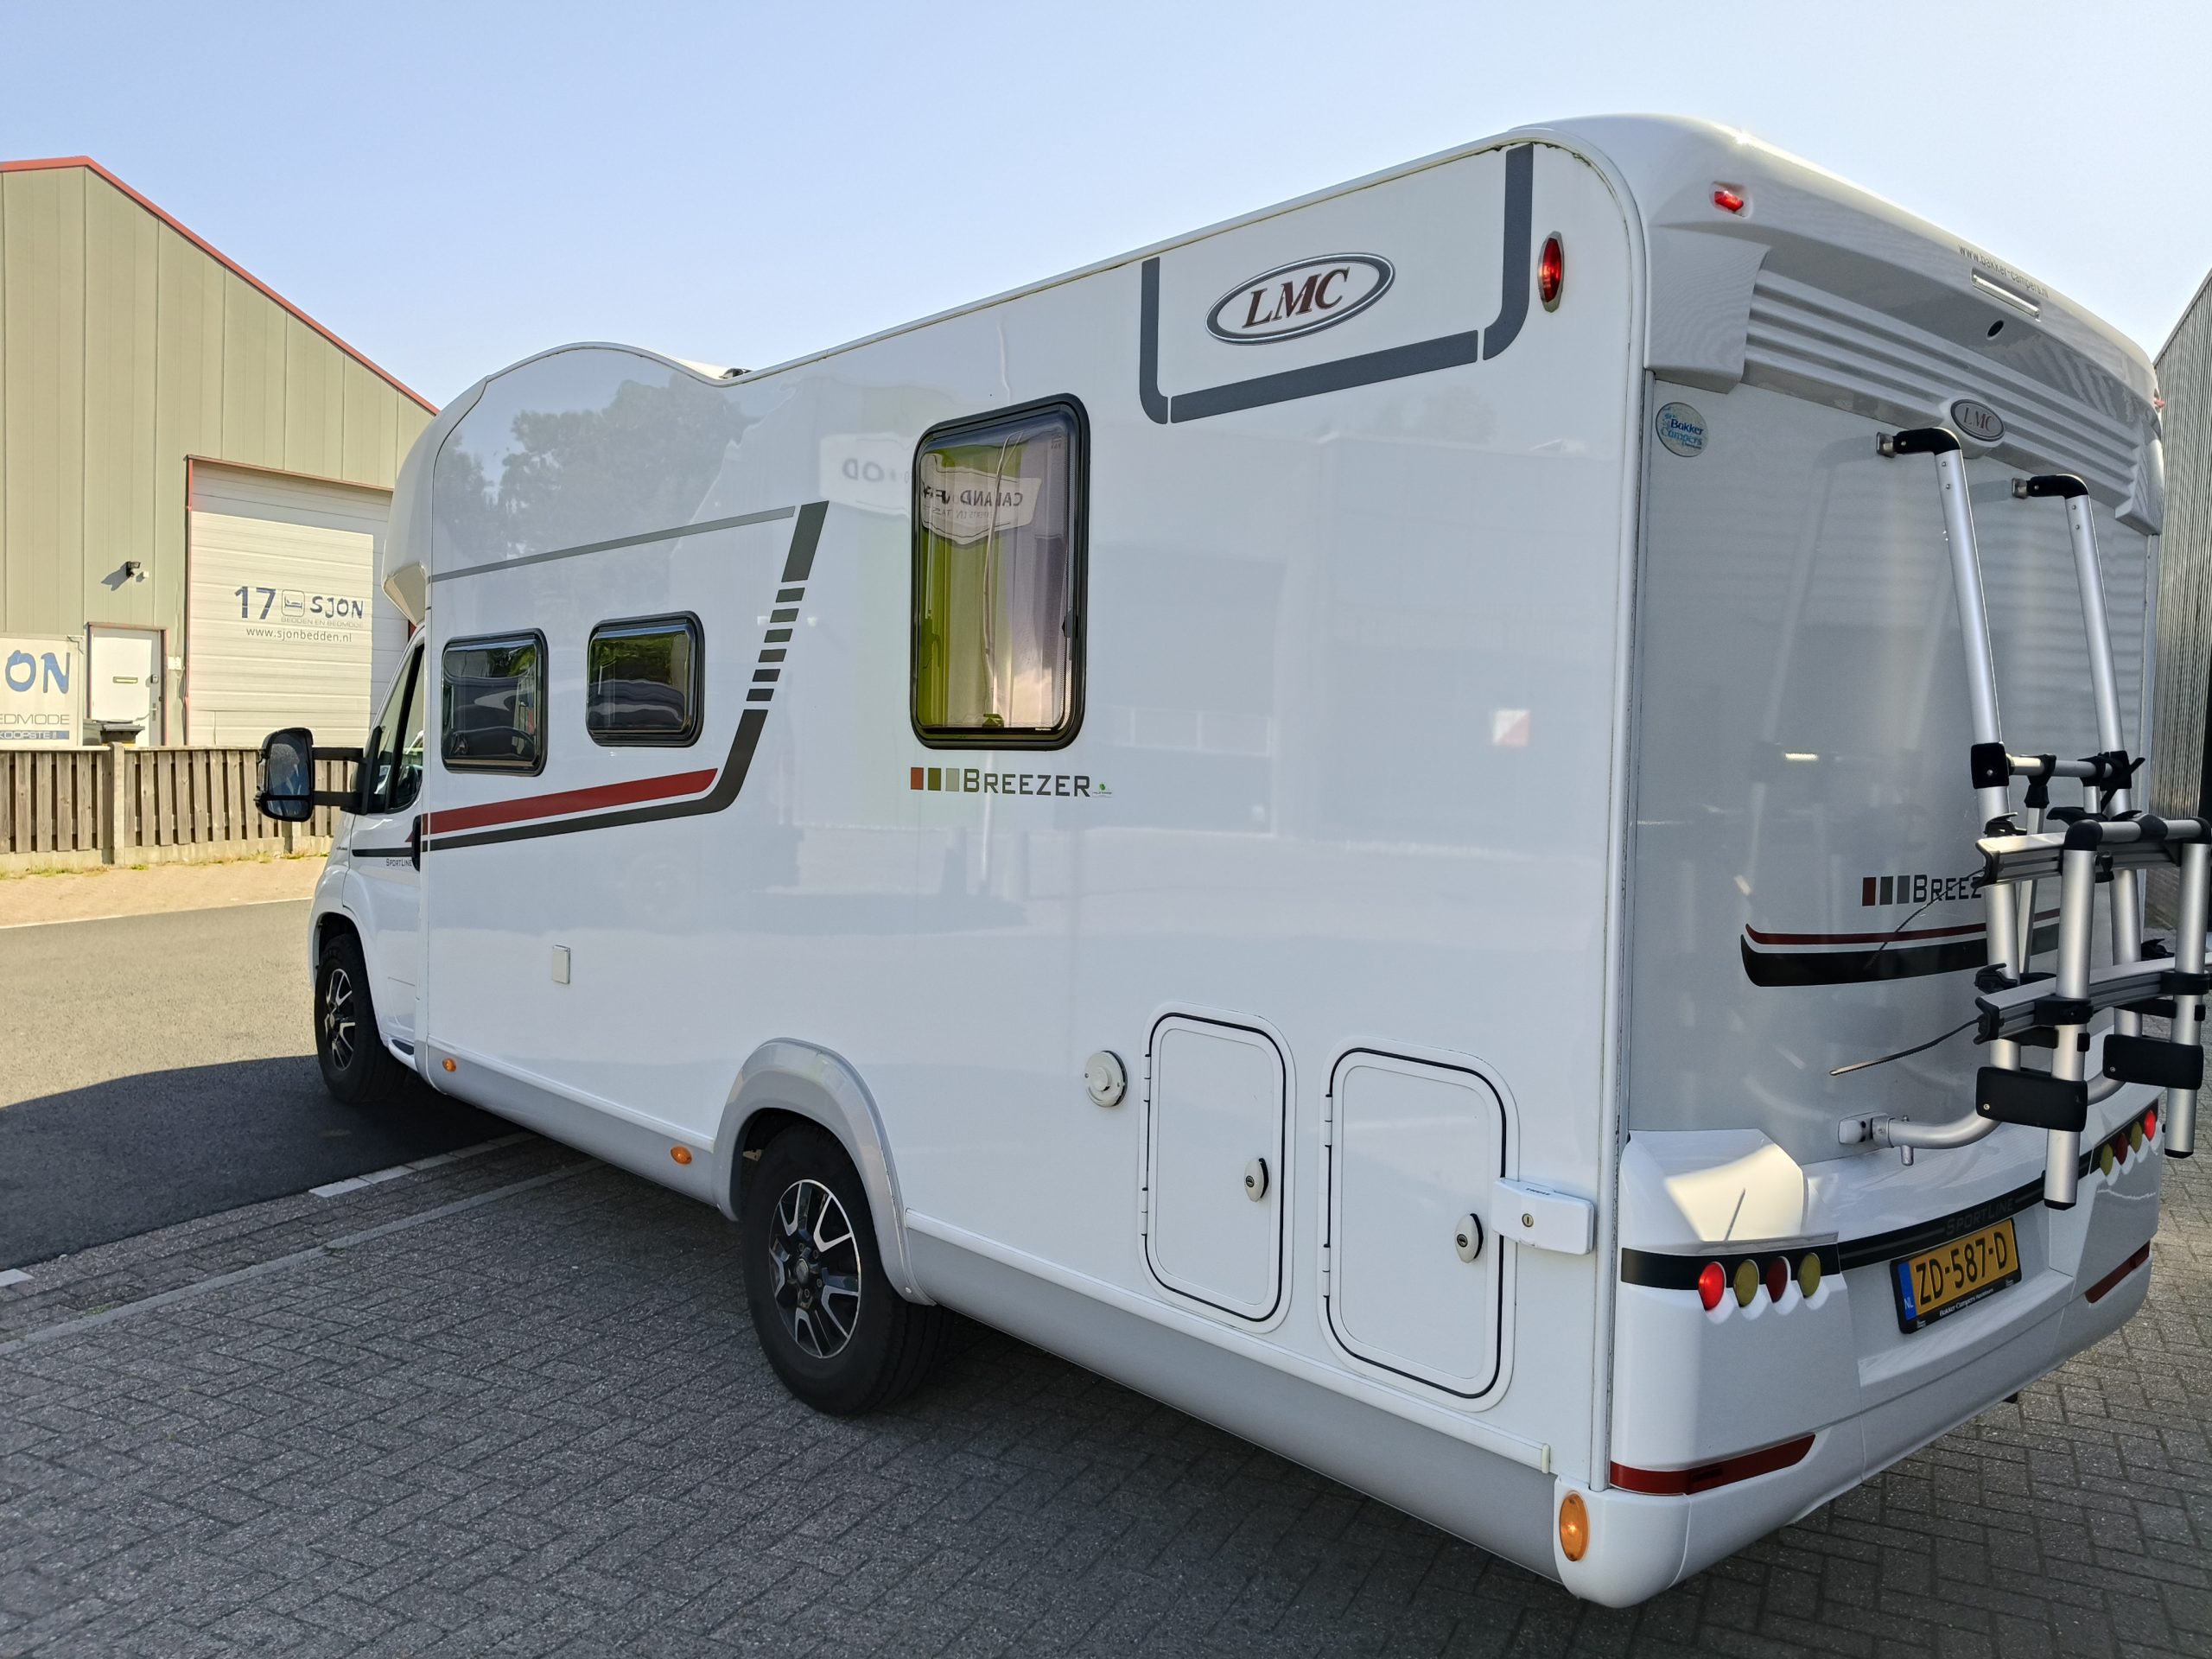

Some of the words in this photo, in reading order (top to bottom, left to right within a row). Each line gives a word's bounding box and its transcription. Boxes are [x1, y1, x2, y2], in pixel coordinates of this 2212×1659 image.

[1242, 266, 1351, 329] LMC
[1670, 418, 1704, 435] Bakker
[1963, 407, 1994, 431] LMC
[234, 586, 276, 620] 17
[310, 595, 364, 619] SJON
[246, 628, 352, 643] www.sjonbedden.nl
[5, 650, 71, 694] ON
[963, 768, 1090, 798] BREEZER
[1904, 1298, 1914, 1310] NL
[1915, 1231, 2007, 1306] ZD-587-D
